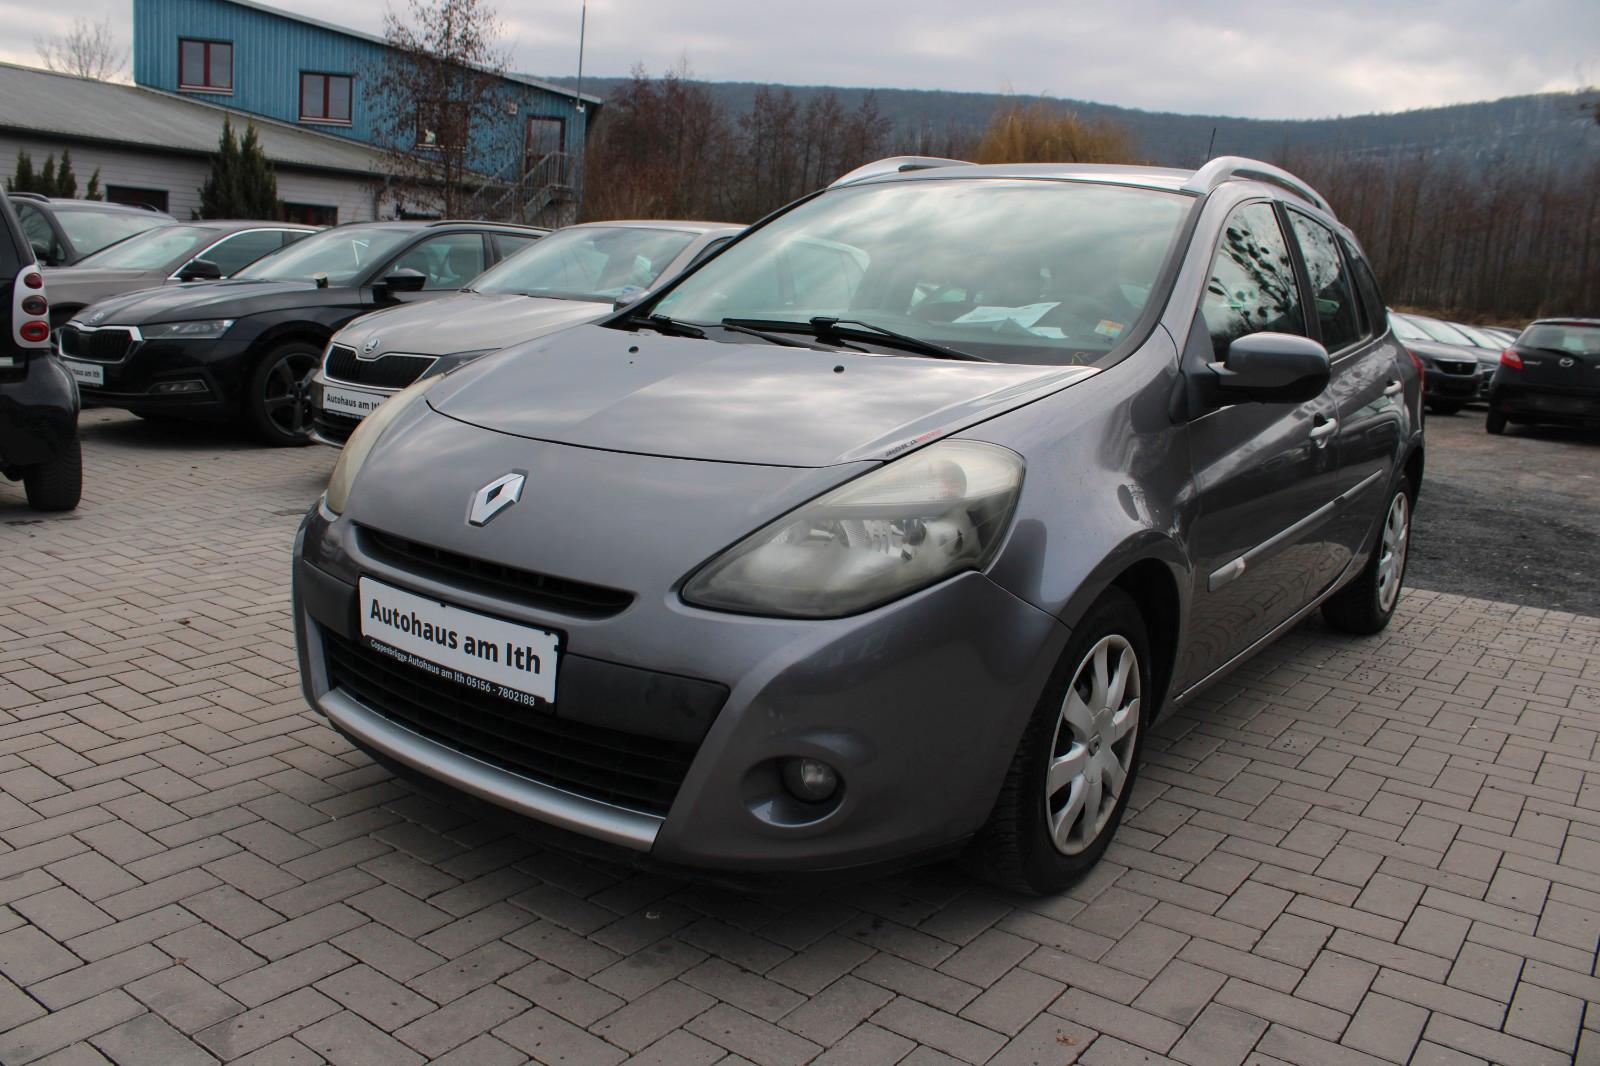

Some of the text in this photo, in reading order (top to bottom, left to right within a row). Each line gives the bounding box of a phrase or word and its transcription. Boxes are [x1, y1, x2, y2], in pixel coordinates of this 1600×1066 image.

[327, 394, 357, 407] Autohaus
[358, 401, 370, 410] am
[370, 599, 541, 675] Autohaus am Ith
[370, 639, 407, 663] Coppenbrügge
[408, 654, 440, 675] Autohaus
[441, 668, 453, 680] am
[454, 671, 465, 684] Ith
[466, 676, 491, 693] 05156
[498, 686, 536, 706] 7802188
